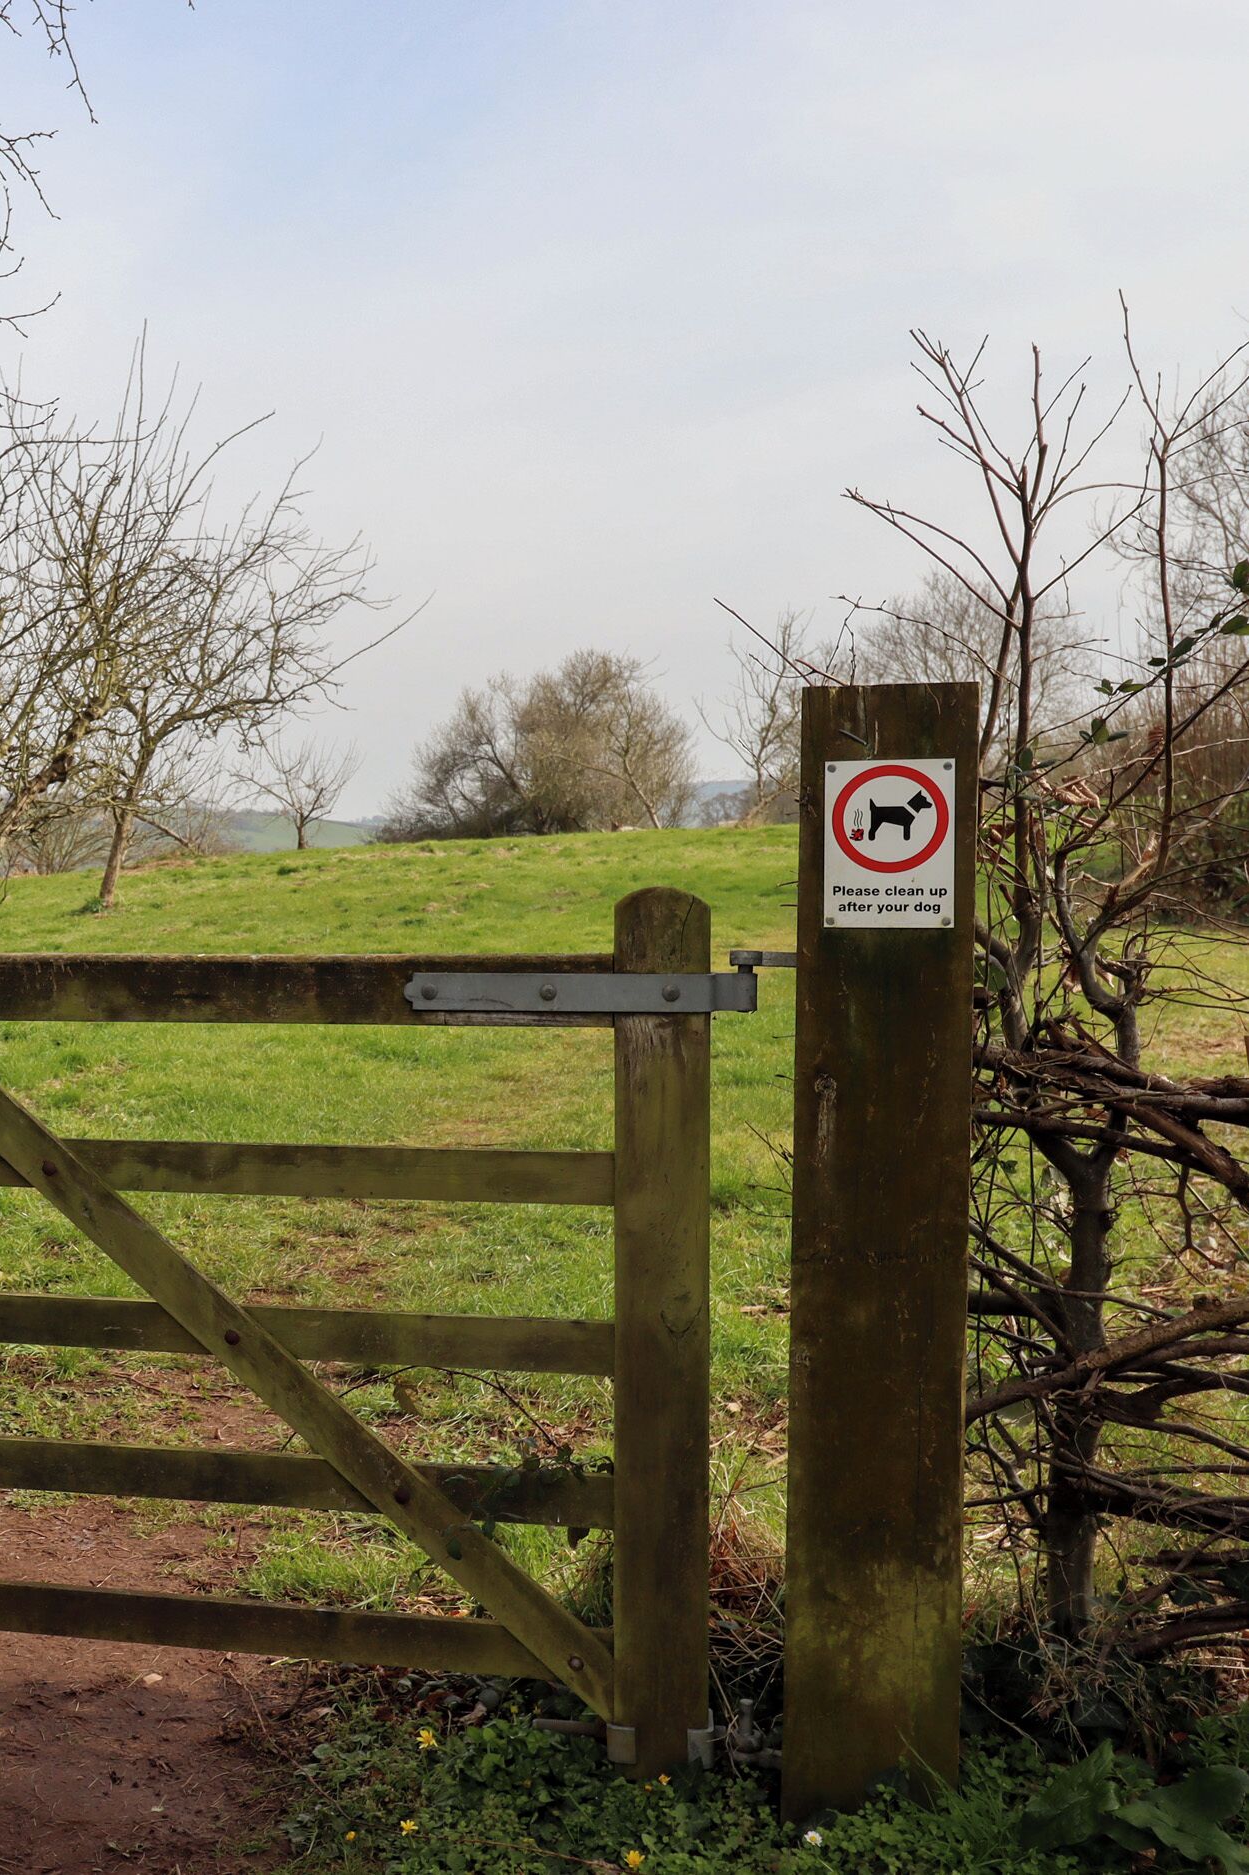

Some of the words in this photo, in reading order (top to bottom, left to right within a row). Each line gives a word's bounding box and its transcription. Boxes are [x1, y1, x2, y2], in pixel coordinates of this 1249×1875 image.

[832, 886, 880, 896] Please
[884, 886, 924, 896] clean
[929, 888, 948, 898] up
[838, 902, 873, 912] after
[877, 904, 909, 914] your
[913, 902, 941, 914] dog
